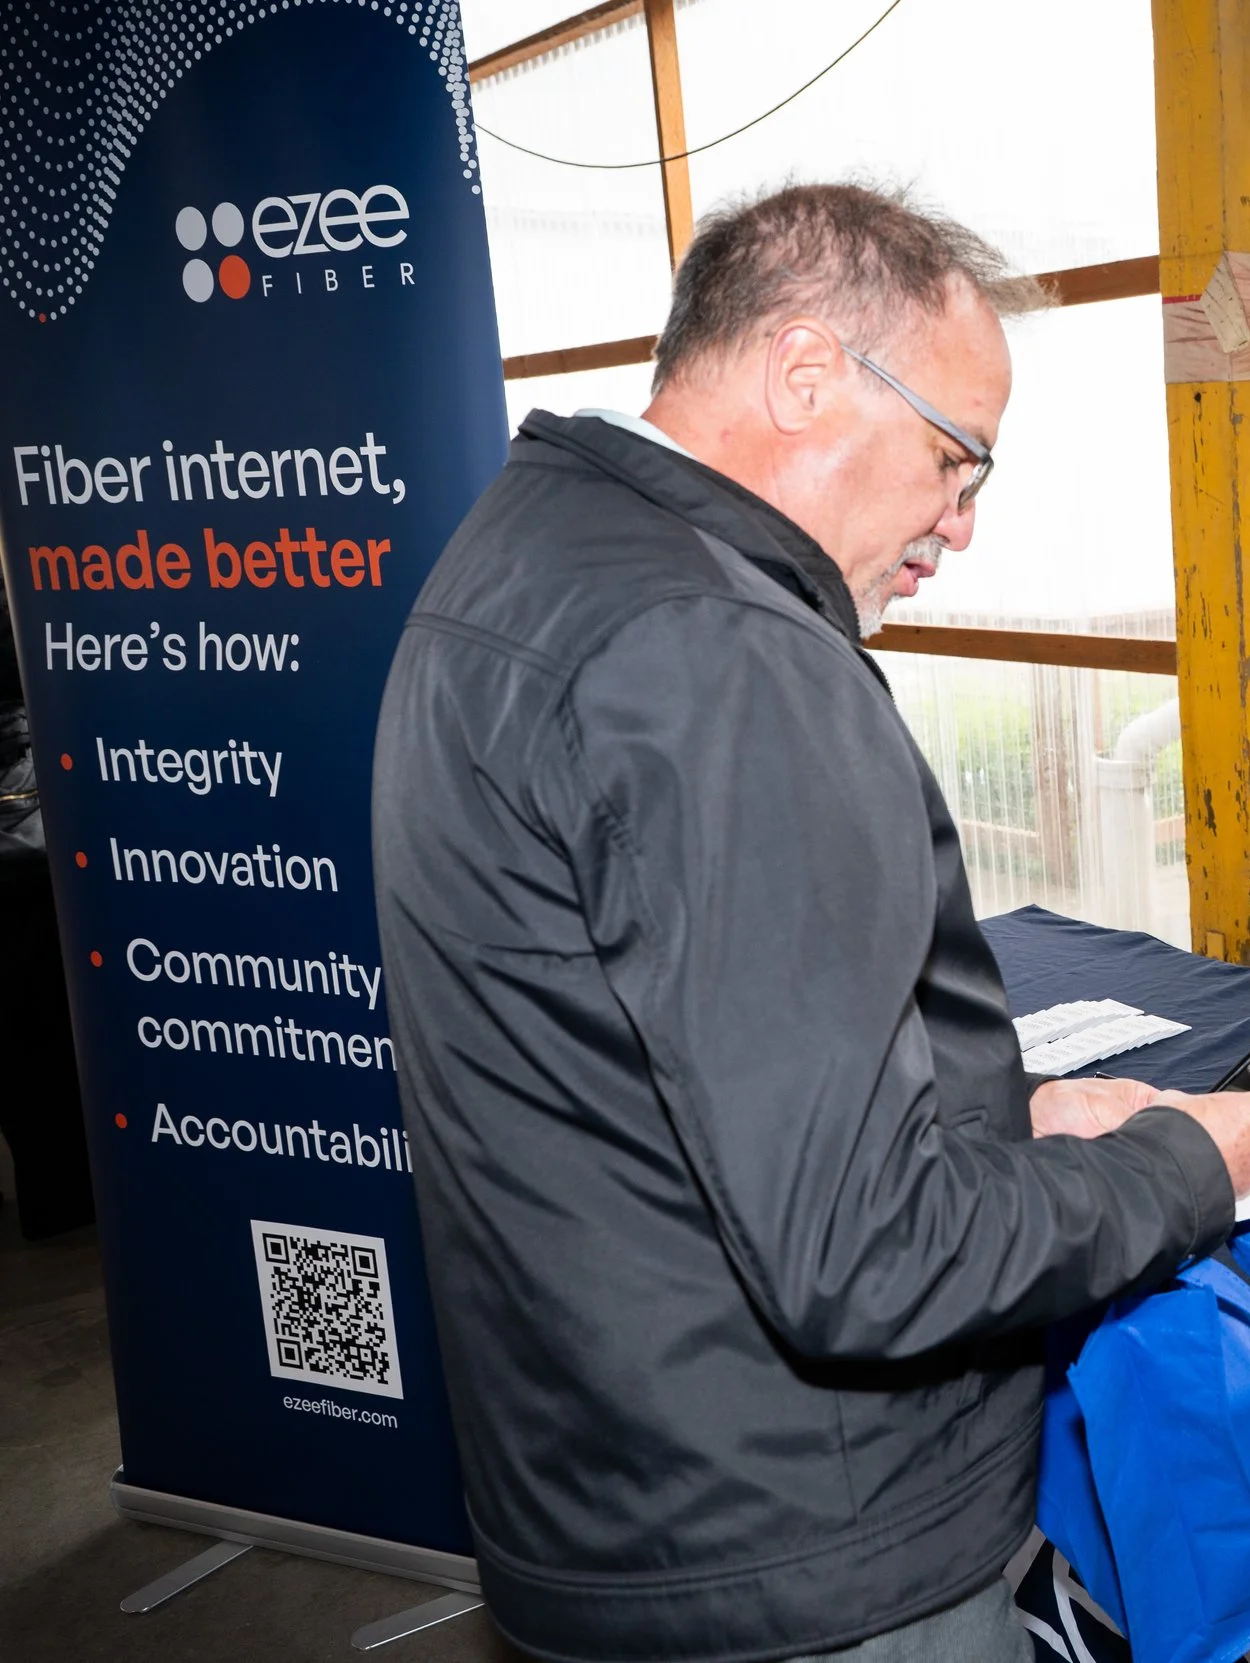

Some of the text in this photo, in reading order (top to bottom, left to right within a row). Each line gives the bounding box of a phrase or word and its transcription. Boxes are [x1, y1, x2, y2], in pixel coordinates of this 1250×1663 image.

[252, 184, 410, 258] ezee
[262, 262, 416, 297] FIBER
[13, 432, 406, 506] Fiber internet,
[28, 527, 392, 591] made better
[45, 621, 300, 672] Here’s how:
[95, 737, 283, 797] Integrity
[109, 837, 339, 892] Innovation
[126, 938, 382, 1010] Community
[137, 1016, 398, 1072] commitmen
[151, 1103, 414, 1173] Accountabili
[283, 1396, 398, 1429] ezeefiber.com
